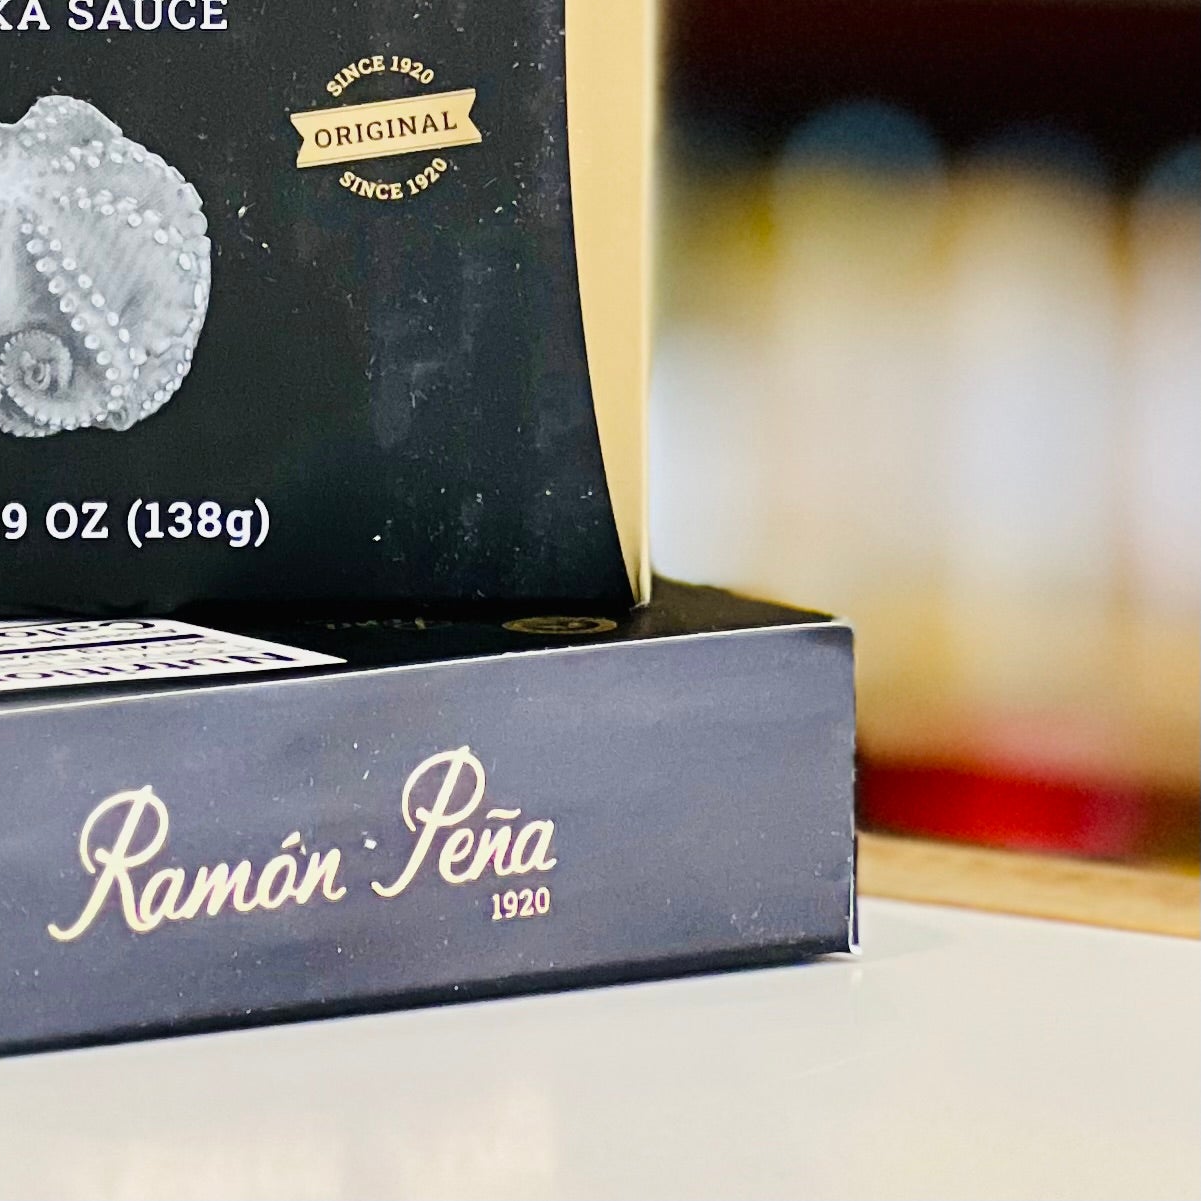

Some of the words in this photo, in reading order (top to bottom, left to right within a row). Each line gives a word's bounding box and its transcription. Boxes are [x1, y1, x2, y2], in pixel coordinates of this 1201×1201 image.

[326, 55, 386, 97] SINCE
[389, 55, 435, 85] 1920
[314, 111, 458, 149] ORIGINAL
[338, 171, 404, 200] SINCE
[406, 157, 448, 196] 1920
[45, 501, 109, 540] OZ
[126, 498, 270, 548] (138g)
[47, 783, 347, 942] Ramón
[371, 745, 558, 898] Peña
[490, 886, 551, 921] 1920
